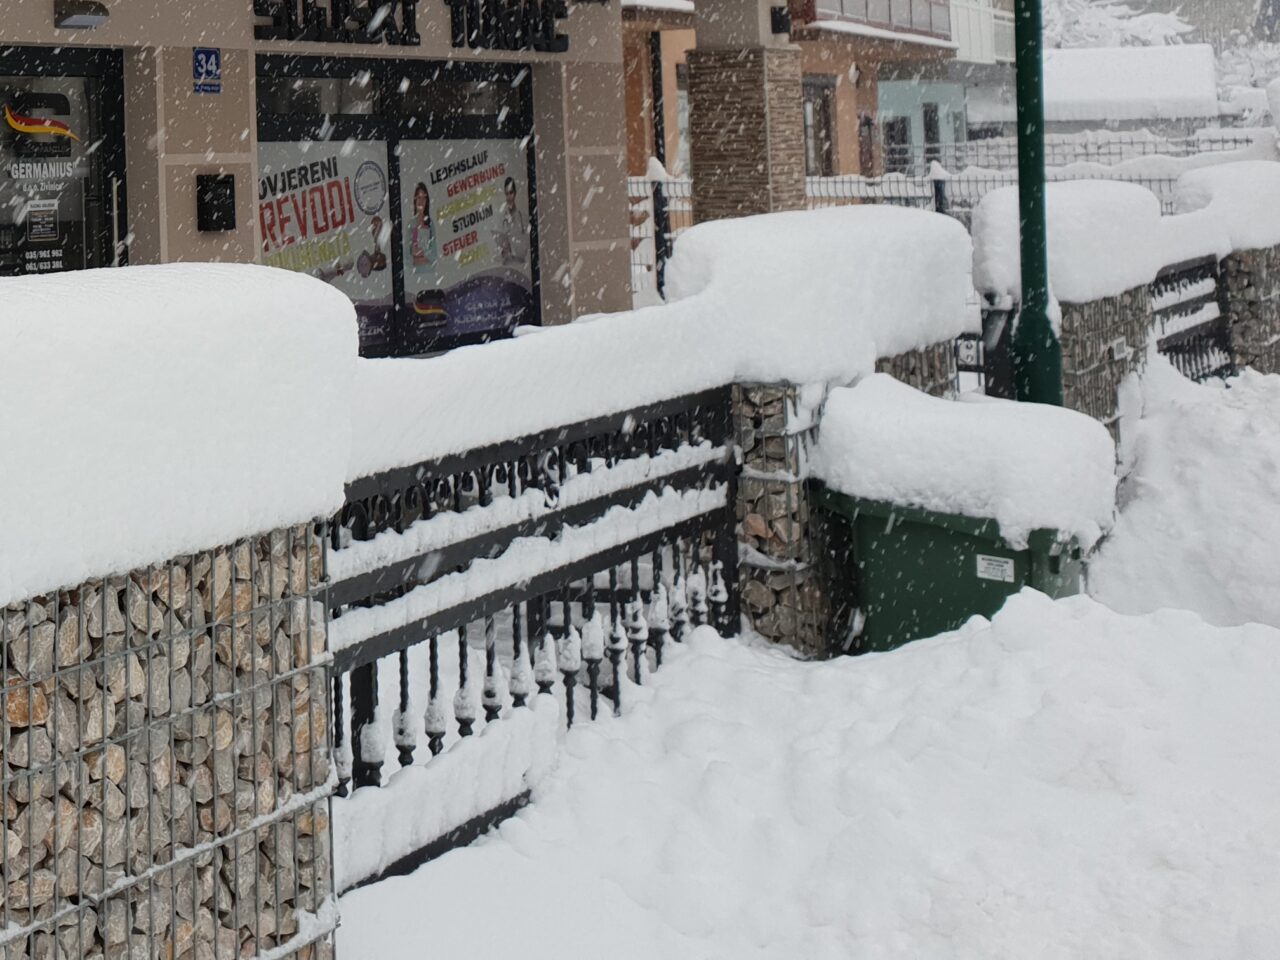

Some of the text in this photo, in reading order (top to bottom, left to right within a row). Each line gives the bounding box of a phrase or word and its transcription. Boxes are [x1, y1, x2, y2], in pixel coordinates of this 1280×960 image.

[197, 52, 218, 74] 34
[447, 163, 505, 198] BEWERBUNG
[452, 204, 493, 233] STUDIUM
[442, 230, 478, 256] STEUER
